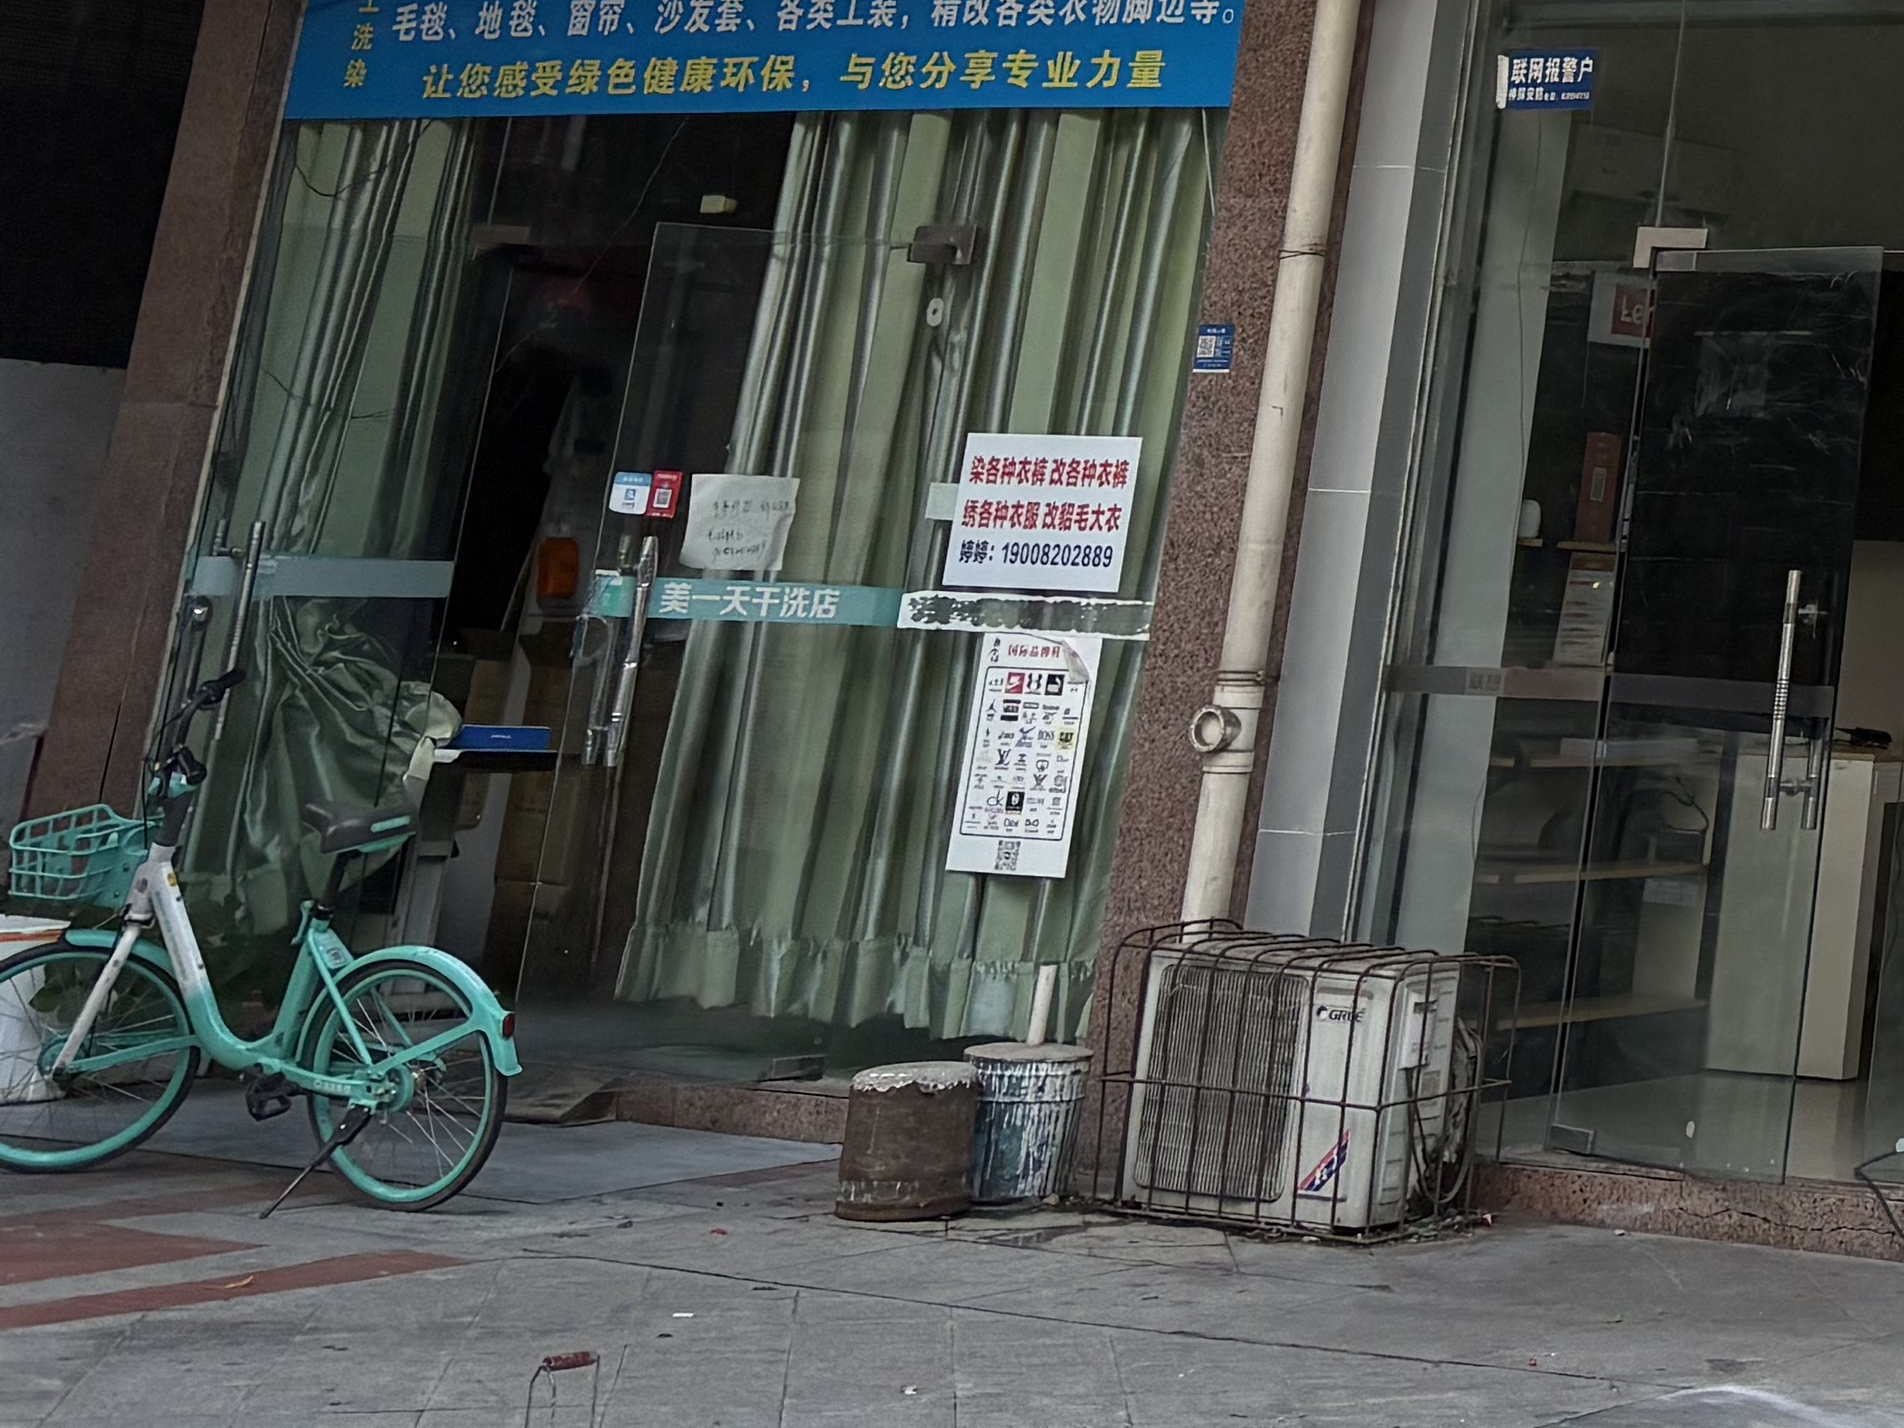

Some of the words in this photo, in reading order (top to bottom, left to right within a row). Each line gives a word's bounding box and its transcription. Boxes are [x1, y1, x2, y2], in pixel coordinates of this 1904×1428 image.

[658, 581, 841, 619] 美一天干洗店
